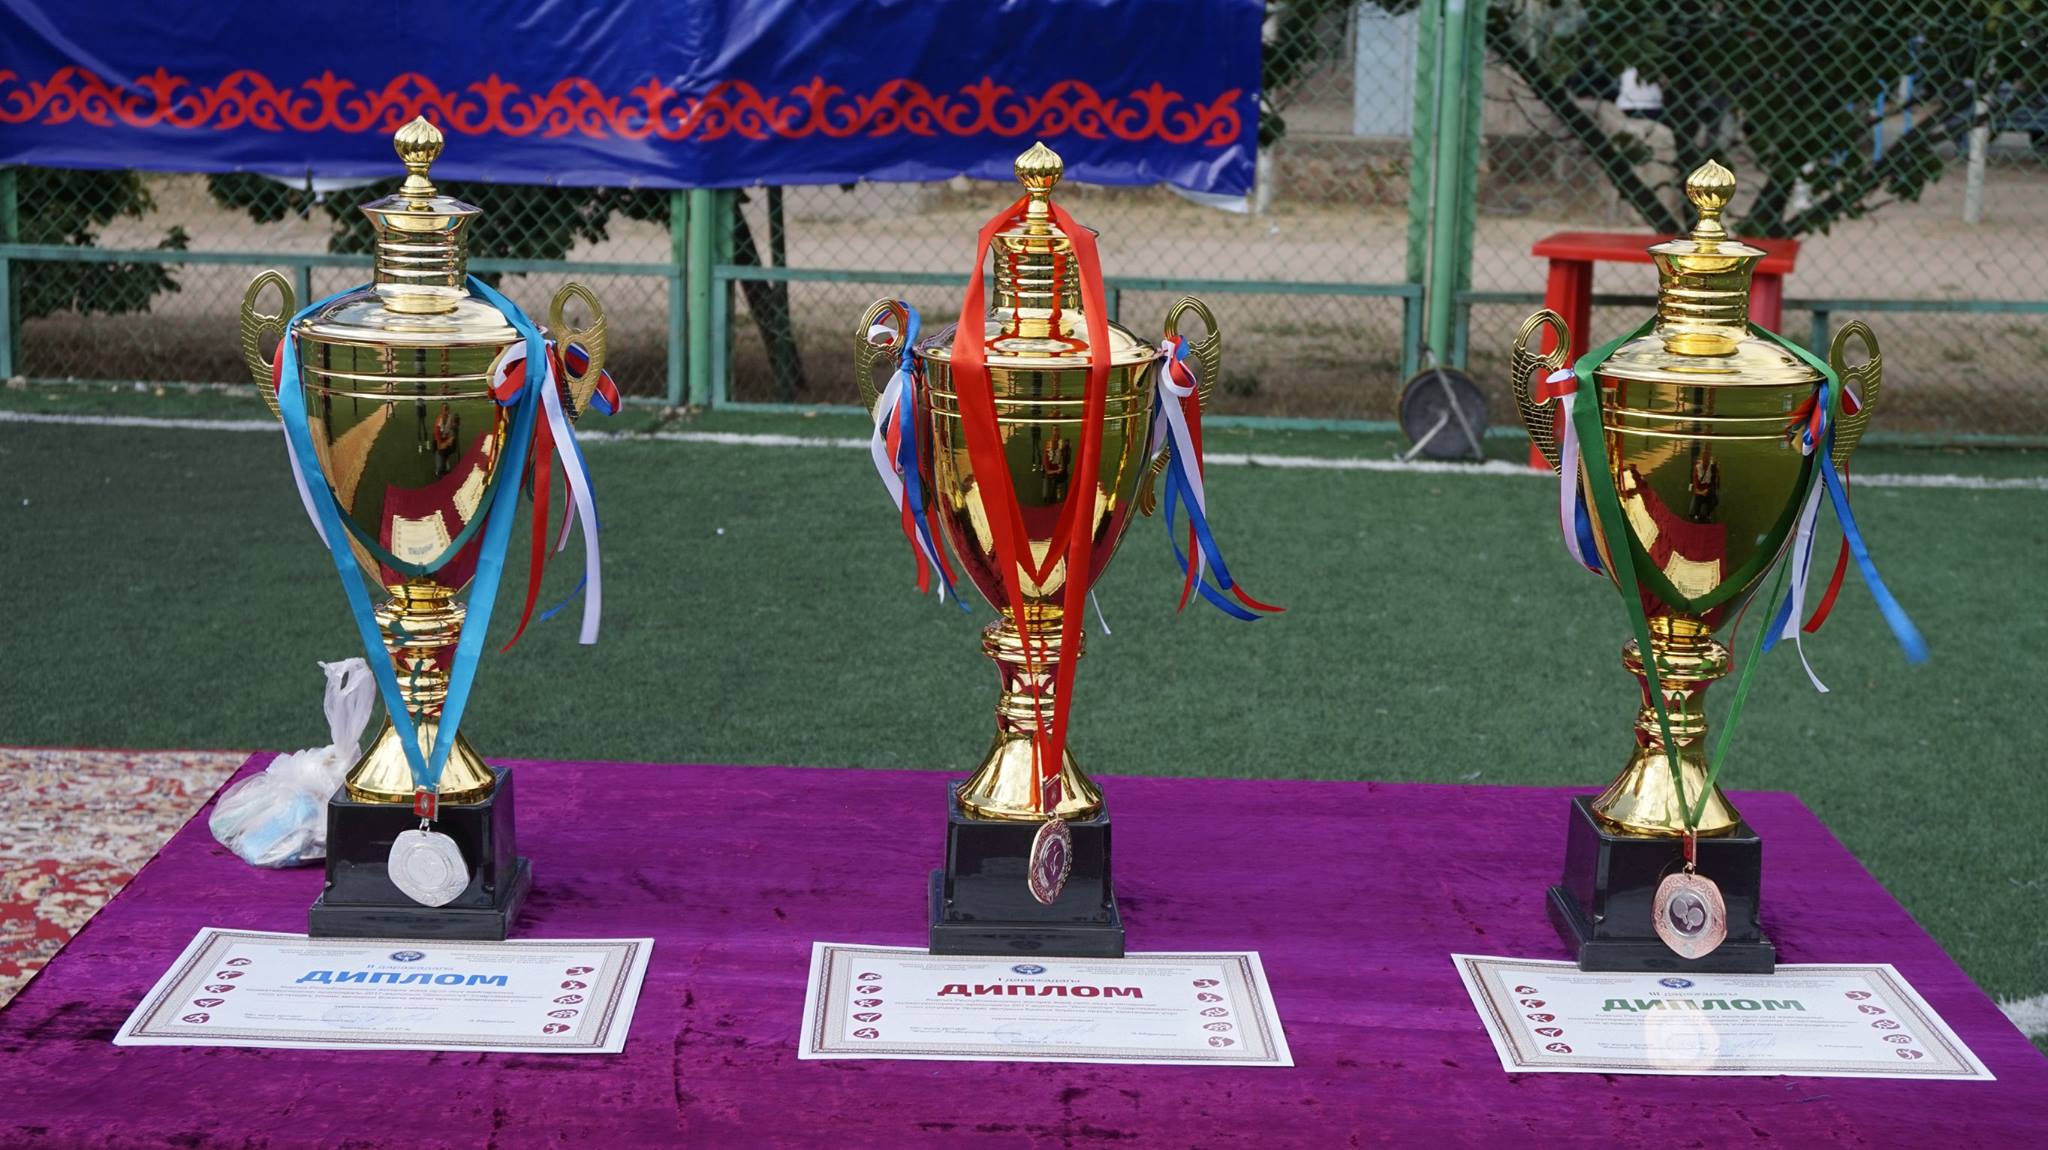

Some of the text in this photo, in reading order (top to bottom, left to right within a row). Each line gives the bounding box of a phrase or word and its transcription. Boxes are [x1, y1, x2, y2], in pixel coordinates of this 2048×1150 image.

[295, 970, 509, 987] ДИПЛОМ
[937, 984, 1143, 998] ДИПЛОМ
[1601, 998, 1806, 1012] ДИПЛОМ
